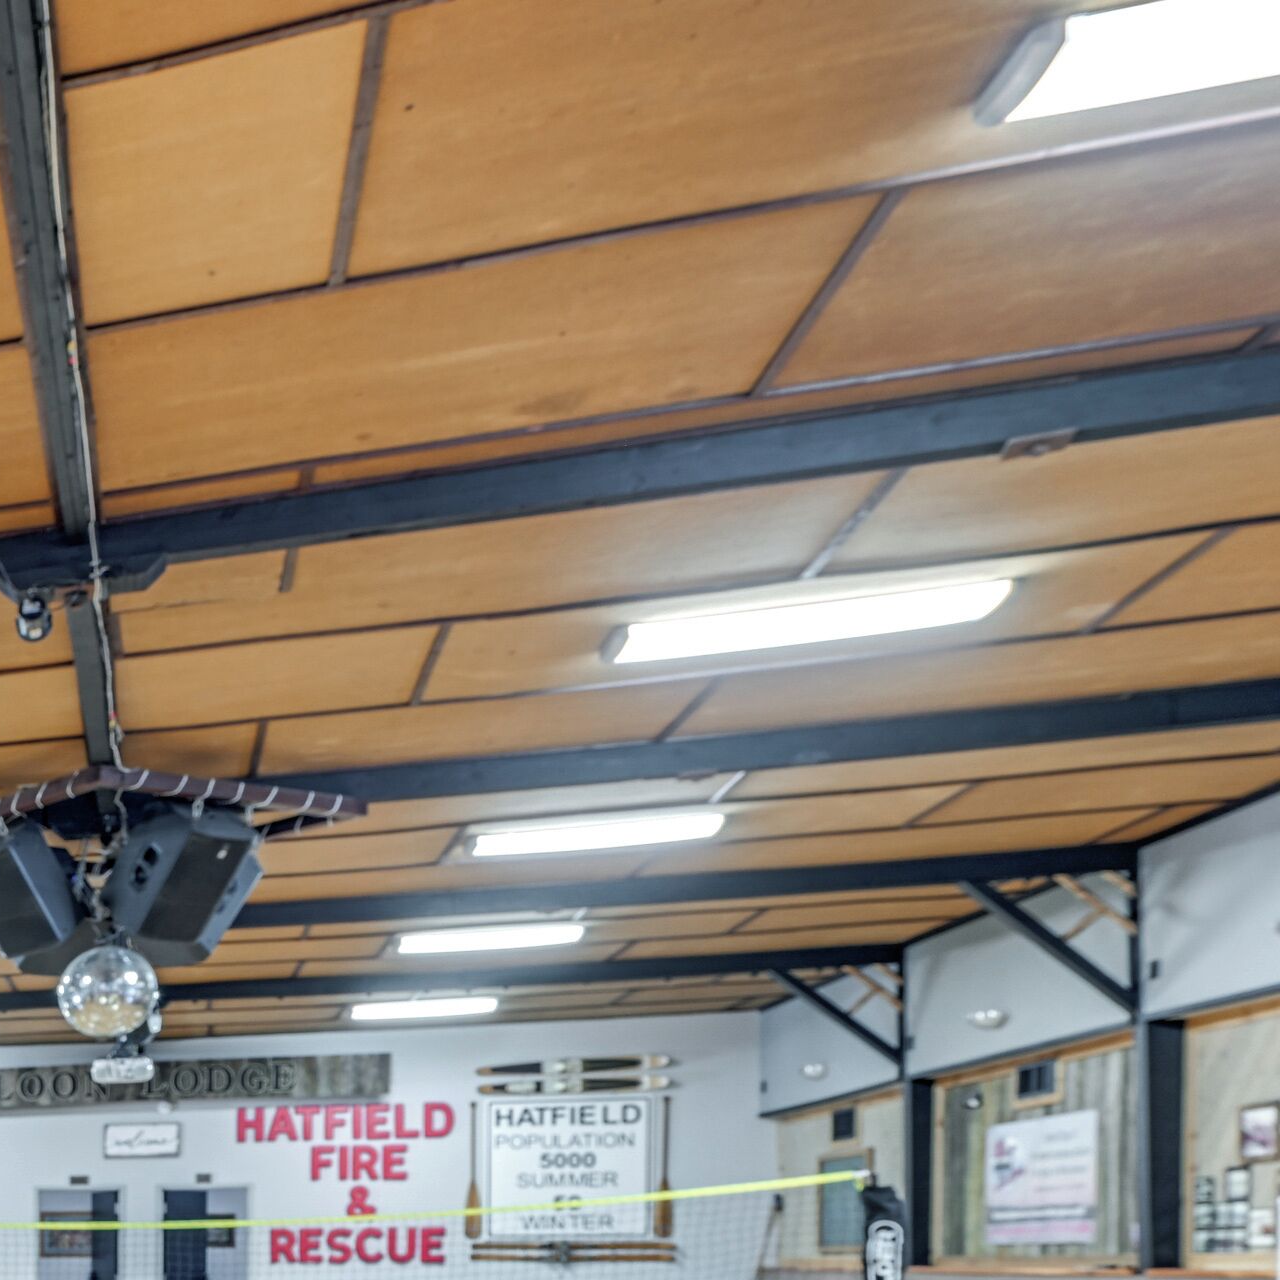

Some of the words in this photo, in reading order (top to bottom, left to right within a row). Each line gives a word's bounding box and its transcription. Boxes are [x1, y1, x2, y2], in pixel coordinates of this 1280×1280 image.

[142, 1060, 297, 1098] LODGE
[236, 1102, 456, 1143] HATFIELD
[495, 1104, 643, 1127] HATFIELD
[495, 1132, 636, 1149] POPULATION
[310, 1144, 409, 1182] FIRE
[540, 1152, 597, 1168] 5000
[516, 1171, 619, 1188] SUMMER
[346, 1185, 377, 1221] &
[522, 1213, 614, 1229] WINTER
[270, 1227, 447, 1264] RESCUE
